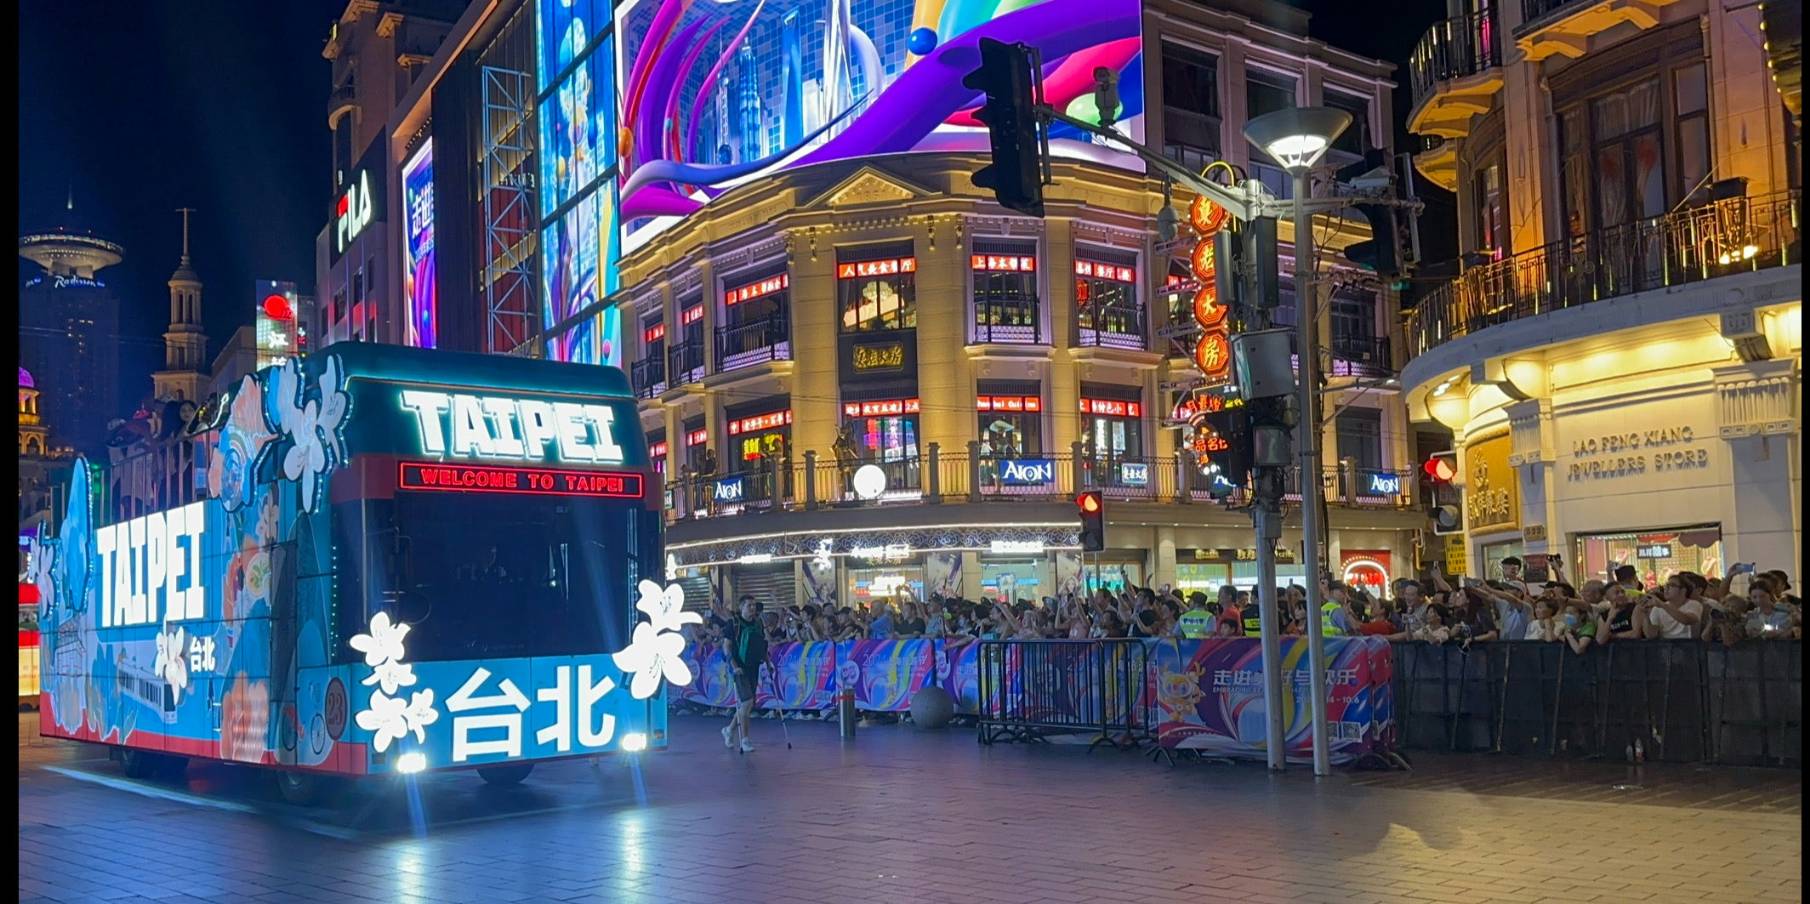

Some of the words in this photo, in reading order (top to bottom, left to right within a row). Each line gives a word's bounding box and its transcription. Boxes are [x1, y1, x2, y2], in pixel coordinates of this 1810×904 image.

[337, 169, 371, 253] FILA
[54, 275, 96, 288] Radisson
[401, 390, 623, 462] TAIPEI
[1573, 439, 1597, 457] LAO
[1602, 433, 1639, 452] FENG
[1644, 426, 1693, 446] XIANG
[420, 468, 516, 488] WELCOME
[528, 474, 554, 489] TO
[565, 475, 623, 492] TAIPEI
[1004, 460, 1052, 481] AION
[1568, 456, 1646, 481] JEWELLERS
[1655, 449, 1708, 471] STORE
[715, 480, 742, 500] AION
[1371, 474, 1399, 493] AION
[97, 501, 204, 628] TAIPEI
[190, 636, 215, 673] 台北
[446, 665, 616, 762] 台北
